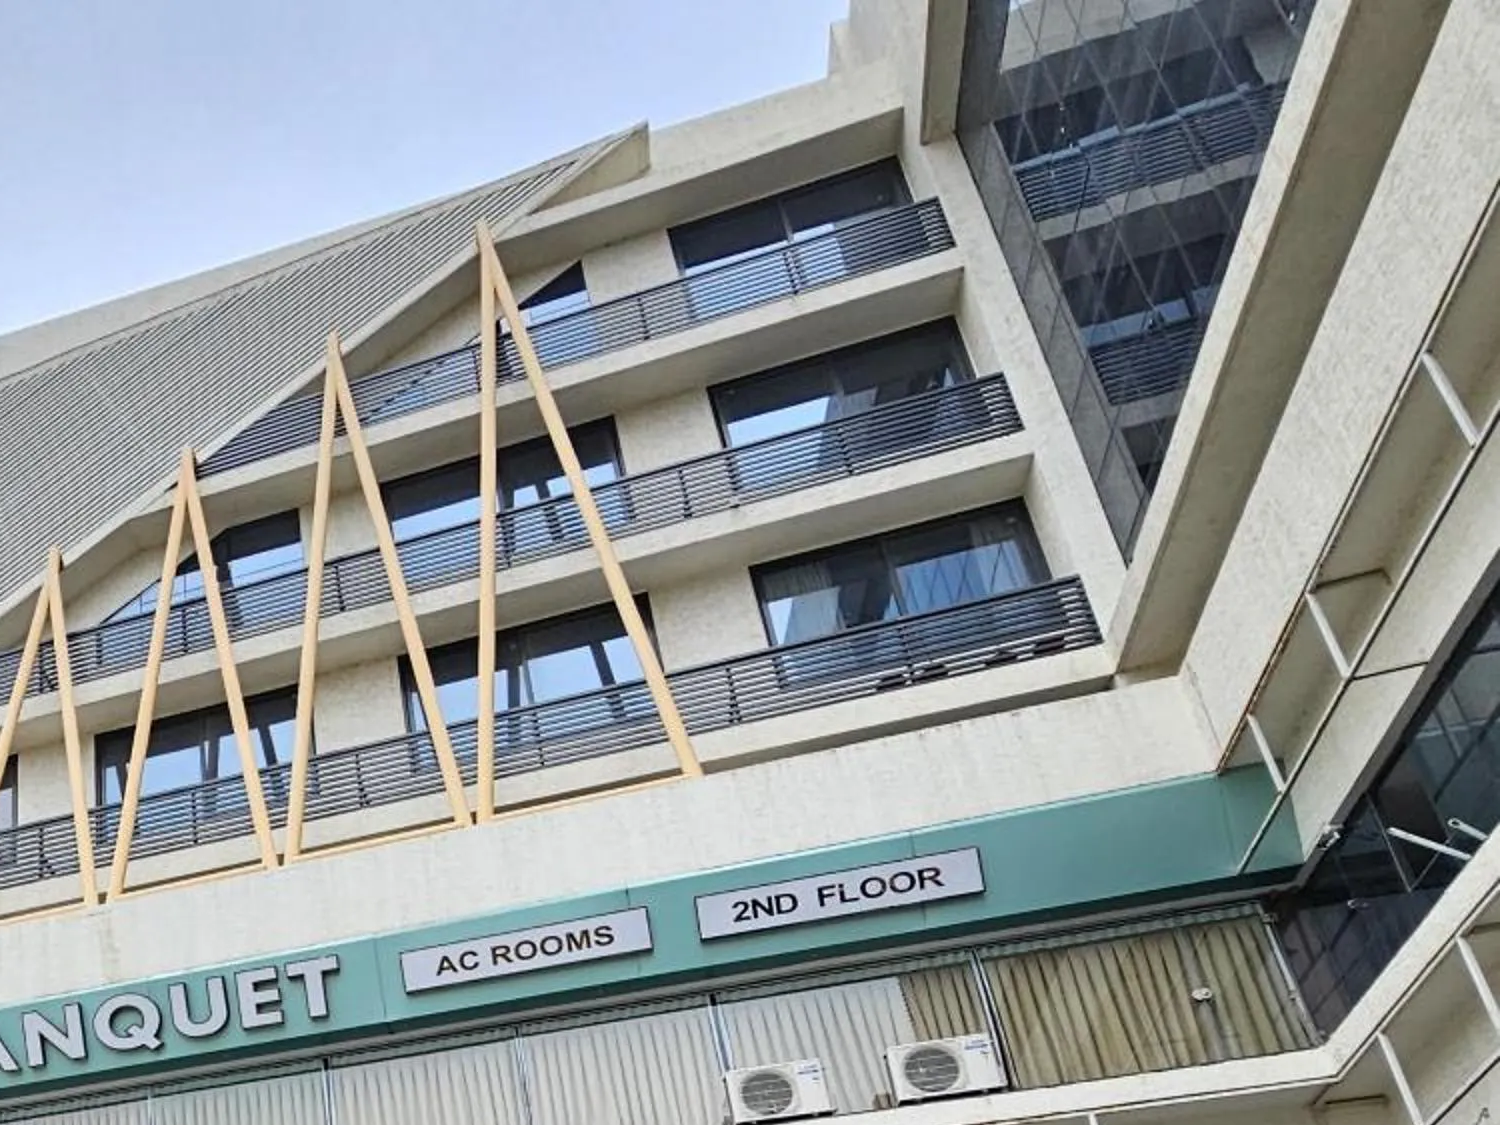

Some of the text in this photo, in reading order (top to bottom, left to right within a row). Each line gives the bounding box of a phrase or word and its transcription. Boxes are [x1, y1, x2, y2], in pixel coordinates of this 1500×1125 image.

[731, 865, 945, 924] 2ND FLOOR
[435, 924, 616, 976] AC ROOMS
